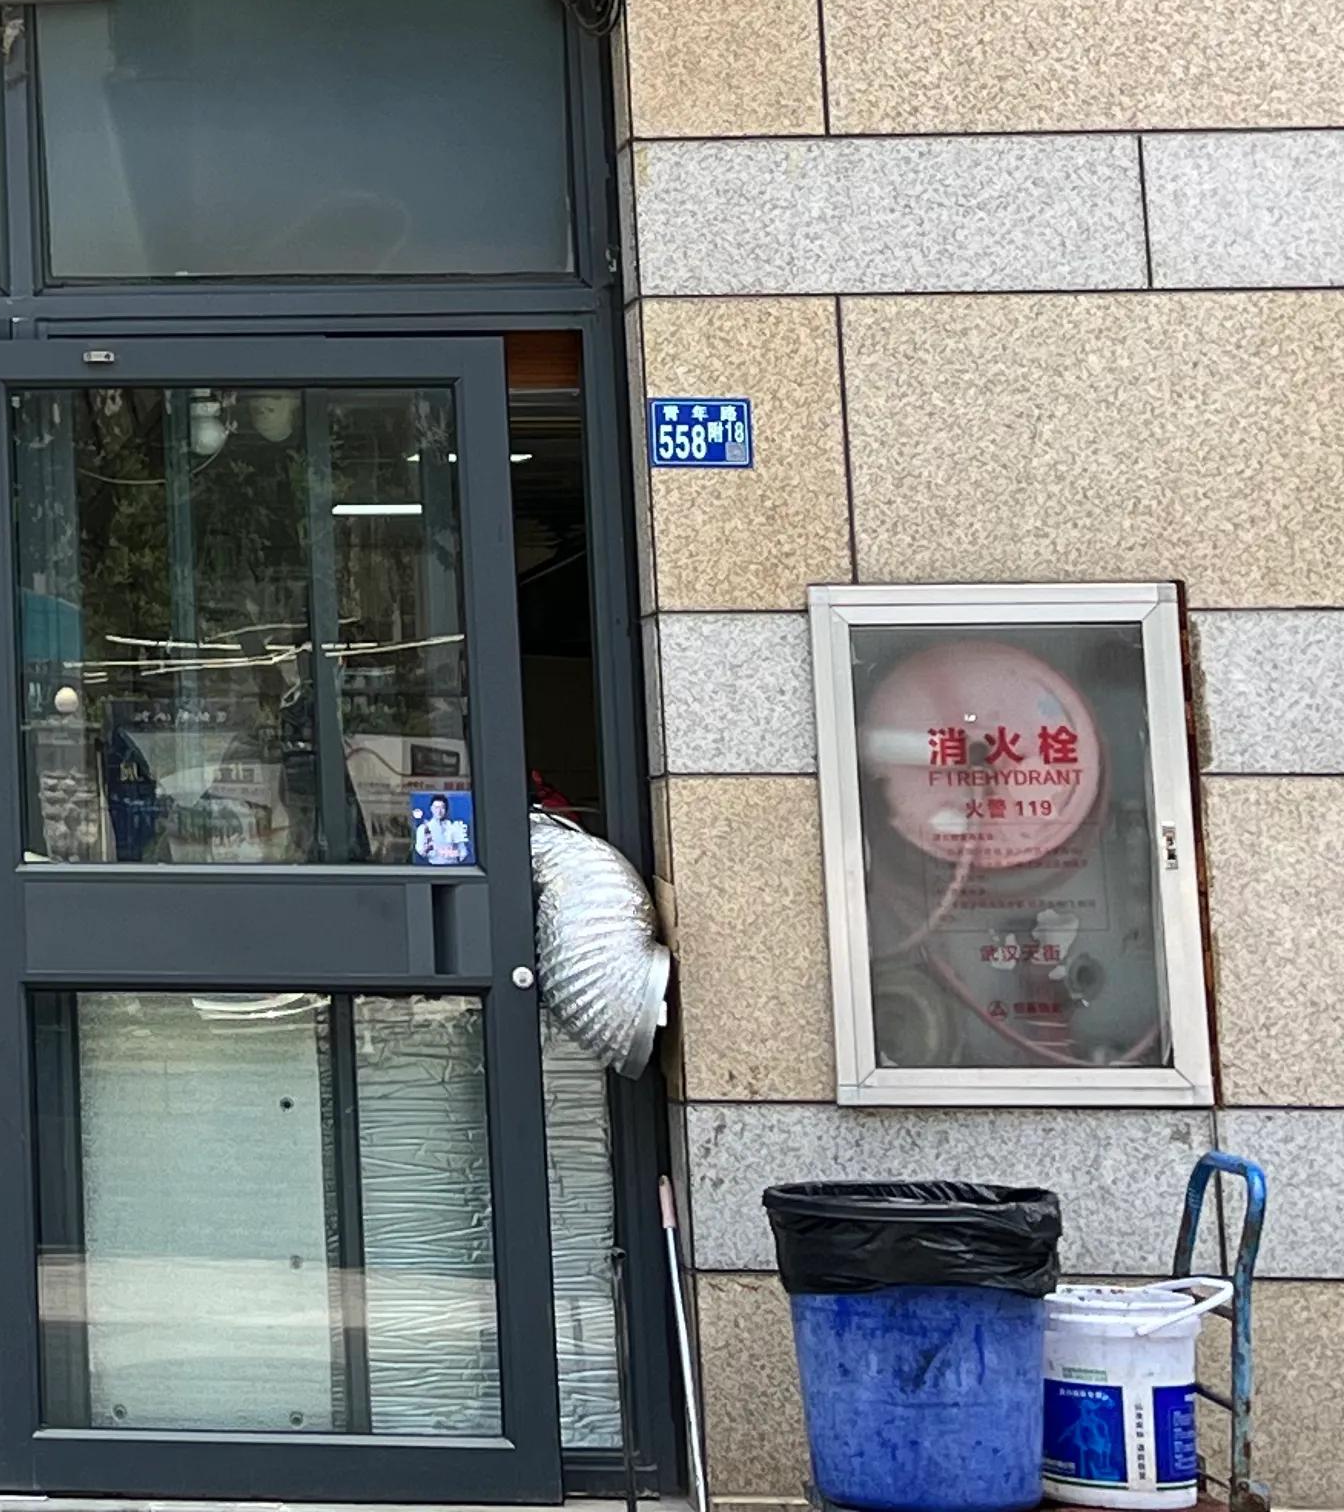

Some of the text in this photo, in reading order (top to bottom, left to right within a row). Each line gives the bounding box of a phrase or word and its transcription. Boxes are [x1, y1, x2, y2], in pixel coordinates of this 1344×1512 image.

[662, 404, 738, 422] 青年路
[927, 725, 1079, 766] 消火栓
[965, 798, 1052, 819] 火警 119
